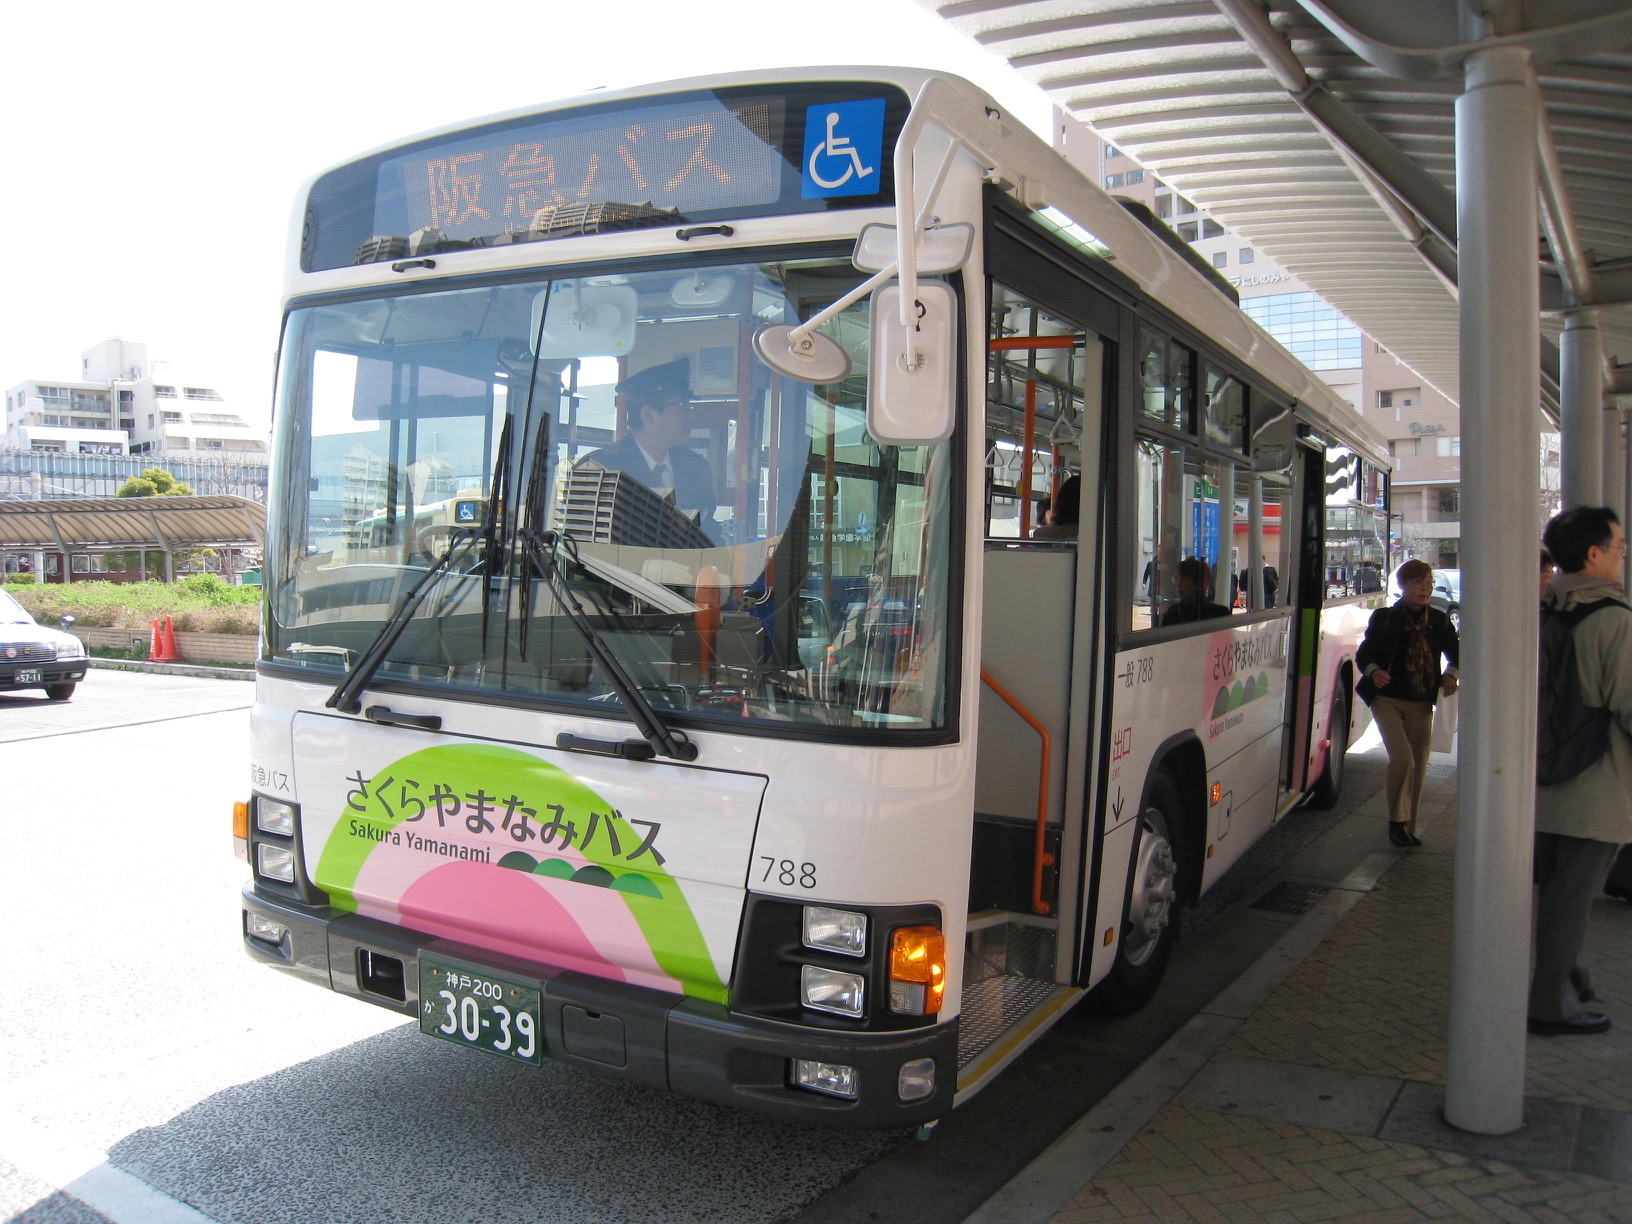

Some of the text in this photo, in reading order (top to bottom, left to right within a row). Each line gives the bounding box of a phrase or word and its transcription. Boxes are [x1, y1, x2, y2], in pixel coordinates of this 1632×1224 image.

[427, 124, 732, 229] 阪急バス
[1137, 656, 1154, 686] 788
[1213, 634, 1272, 681] さくらやまなみバス
[1112, 726, 1132, 763] 出口
[345, 769, 667, 867] さくらやまなみバス
[349, 819, 491, 865] Sakura Yamanami
[760, 856, 817, 889] 788
[439, 990, 535, 1058] 30-39
